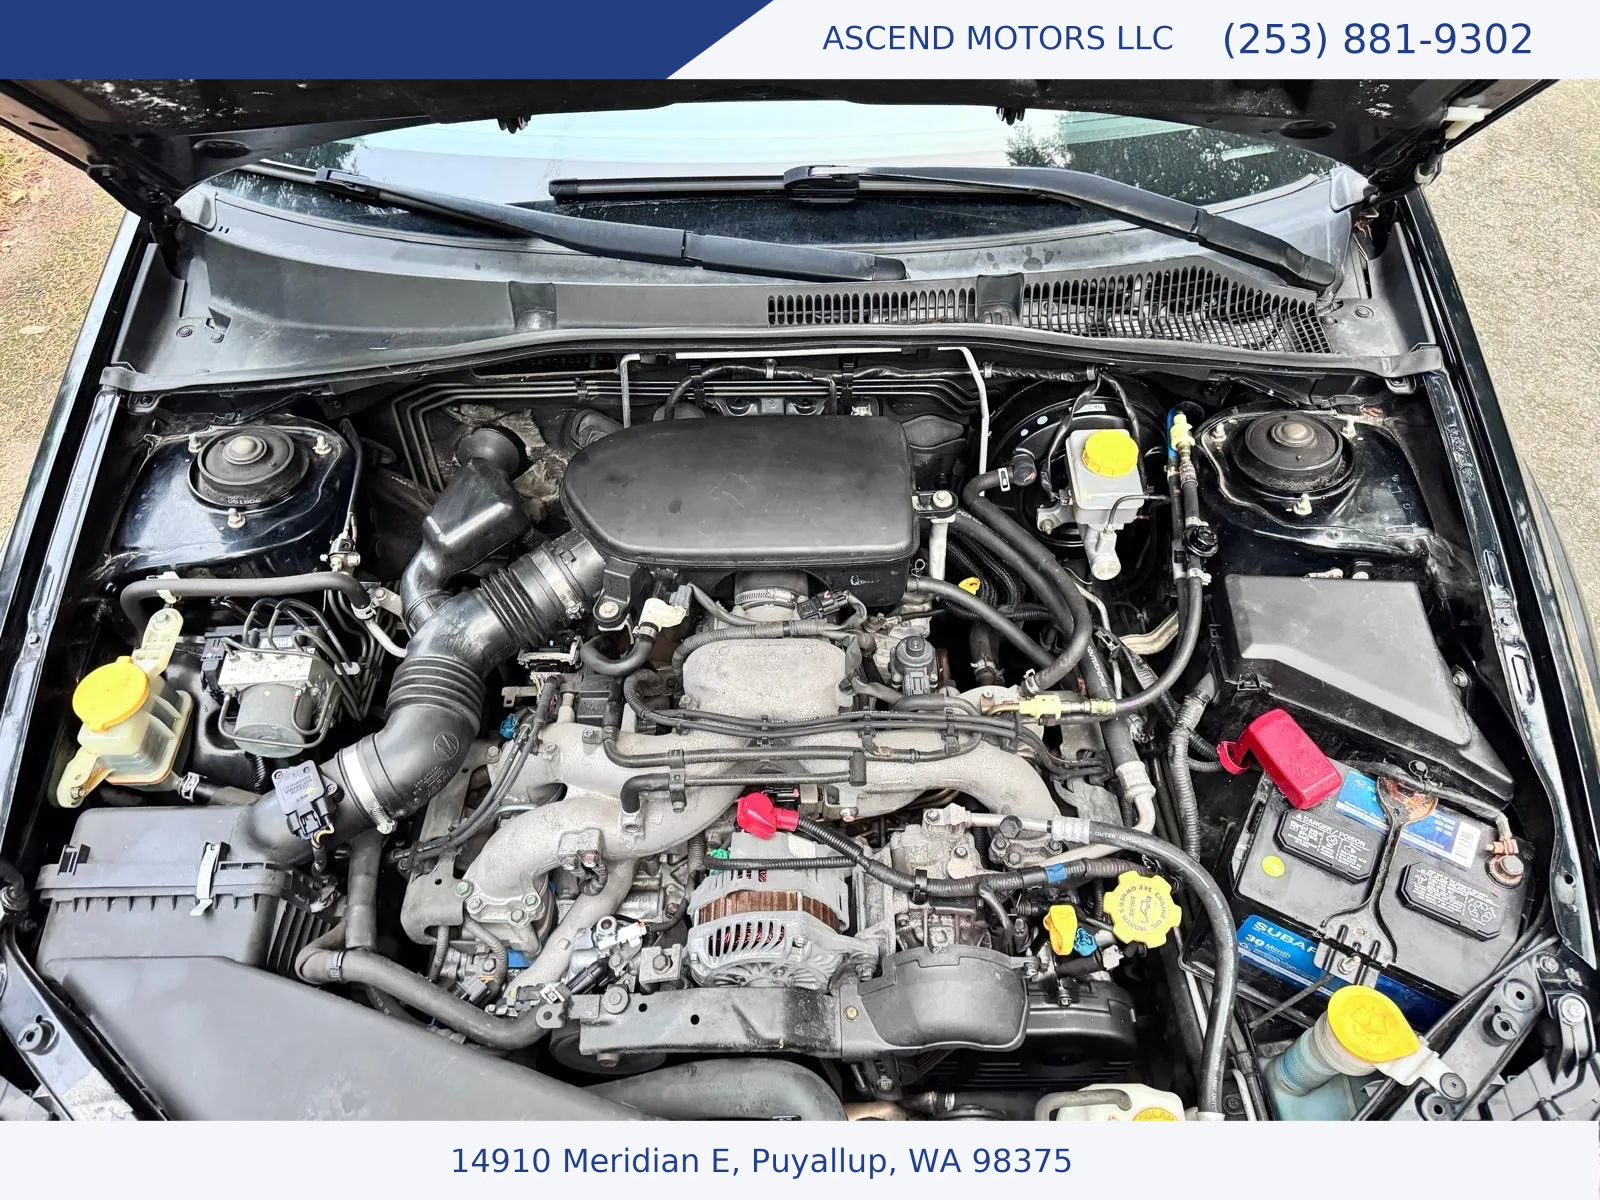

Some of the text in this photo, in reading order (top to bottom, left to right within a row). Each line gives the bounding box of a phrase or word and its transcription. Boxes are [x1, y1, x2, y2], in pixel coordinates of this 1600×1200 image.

[1303, 815, 1332, 833] DANGER
[1339, 831, 1366, 848] POISON
[1245, 934, 1266, 947] 30
